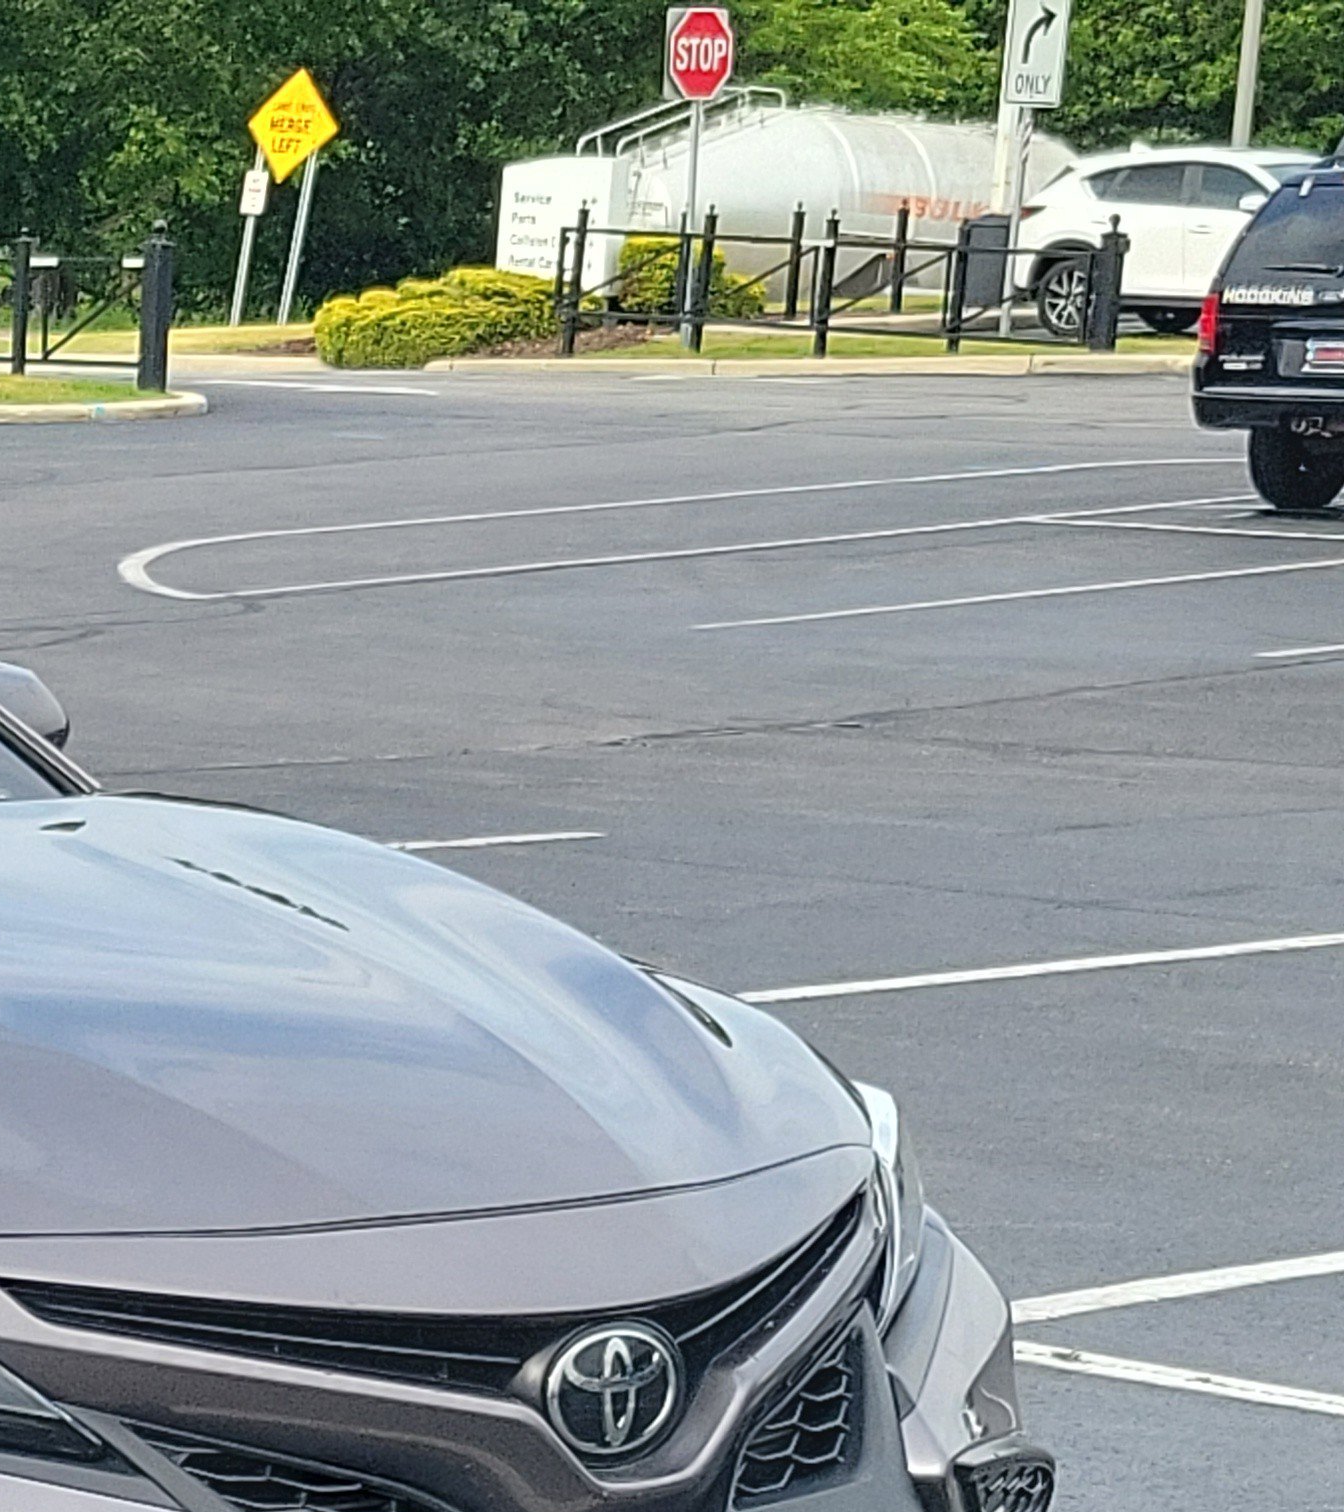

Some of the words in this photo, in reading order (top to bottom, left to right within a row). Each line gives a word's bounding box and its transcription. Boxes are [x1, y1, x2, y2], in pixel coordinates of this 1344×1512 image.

[675, 36, 727, 73] STOP
[1014, 73, 1053, 95] ONLY
[270, 115, 313, 133] MERGE
[271, 136, 302, 154] LEFT
[514, 191, 552, 205] Service
[511, 212, 536, 225] Parts
